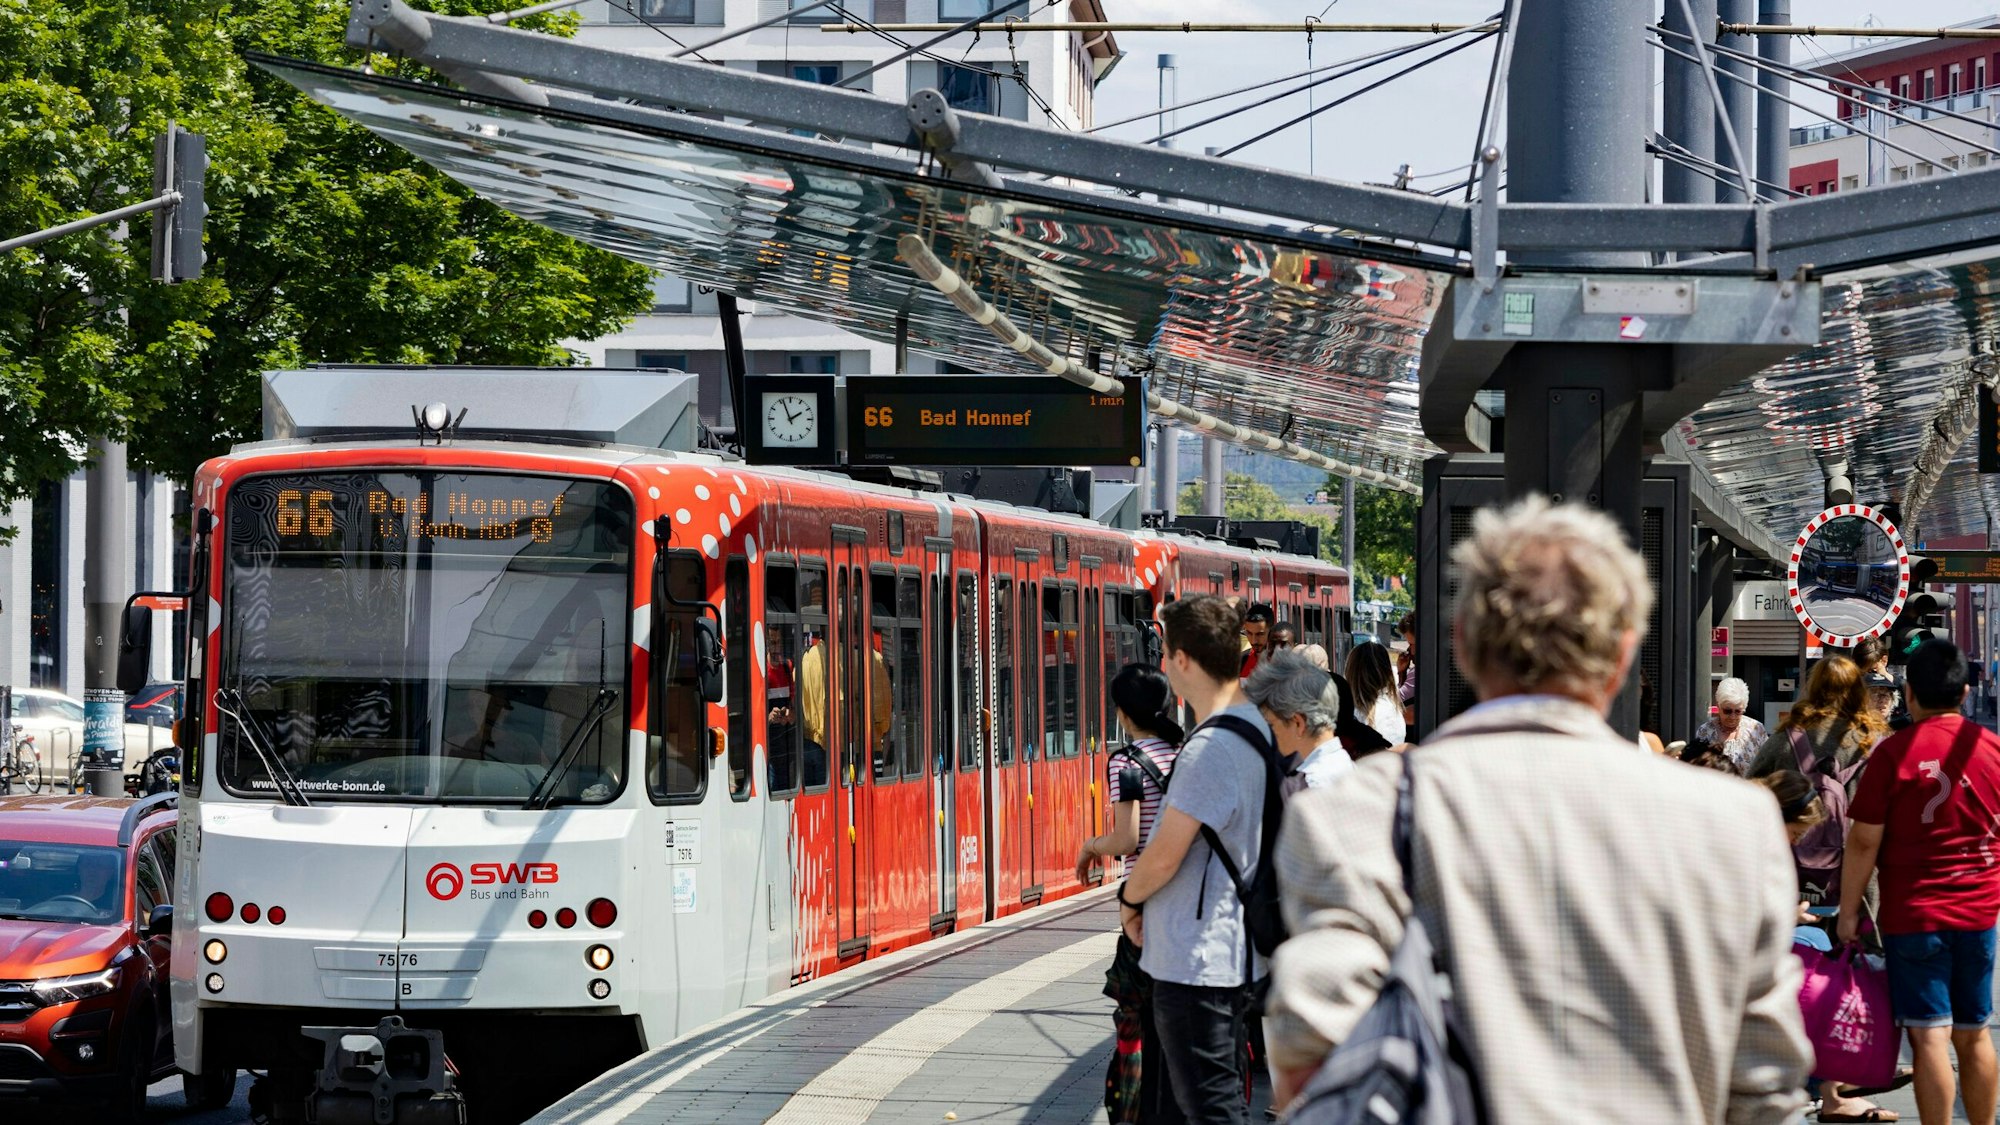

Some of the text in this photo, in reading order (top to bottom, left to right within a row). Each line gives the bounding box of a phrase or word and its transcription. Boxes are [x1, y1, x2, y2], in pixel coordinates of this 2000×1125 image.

[1090, 395, 1125, 406] 1 min
[864, 406, 1032, 427] 66 Bad Honnef
[278, 490, 564, 536] 66 Bad Honnef
[412, 516, 467, 539] Bonn
[480, 517, 518, 539] Hbf
[251, 778, 386, 792] wwwstdtwerke-bonn.de
[678, 848, 692, 860] 7576
[470, 862, 559, 885] SWB
[470, 889, 550, 900] Bus und Bahn
[402, 983, 412, 995] B
[1829, 1024, 1873, 1046] ALDI
